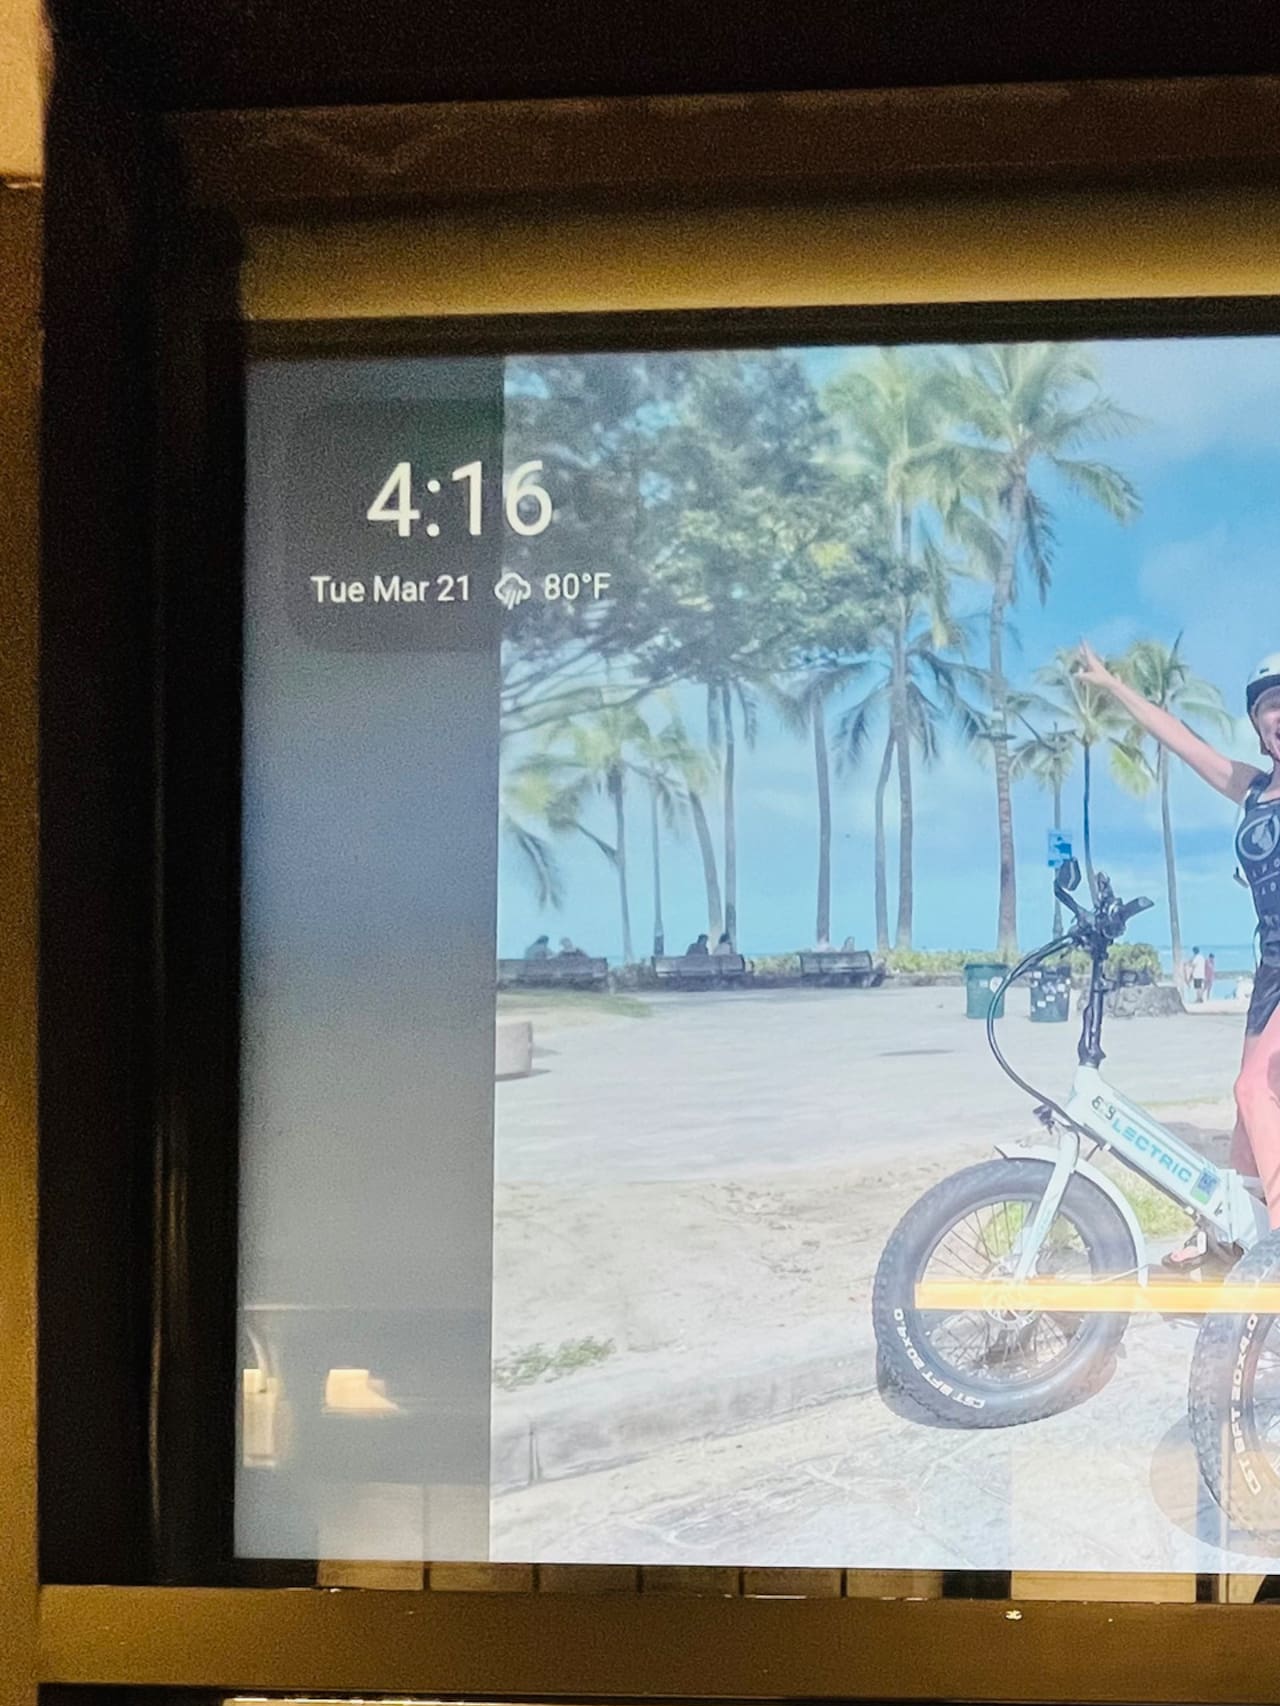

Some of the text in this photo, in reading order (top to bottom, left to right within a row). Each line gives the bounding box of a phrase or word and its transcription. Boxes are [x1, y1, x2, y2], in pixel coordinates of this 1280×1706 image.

[366, 459, 553, 538] 4:16
[310, 572, 612, 603] Tue Mar 21 80°F
[1111, 1117, 1192, 1184] LECTRIC
